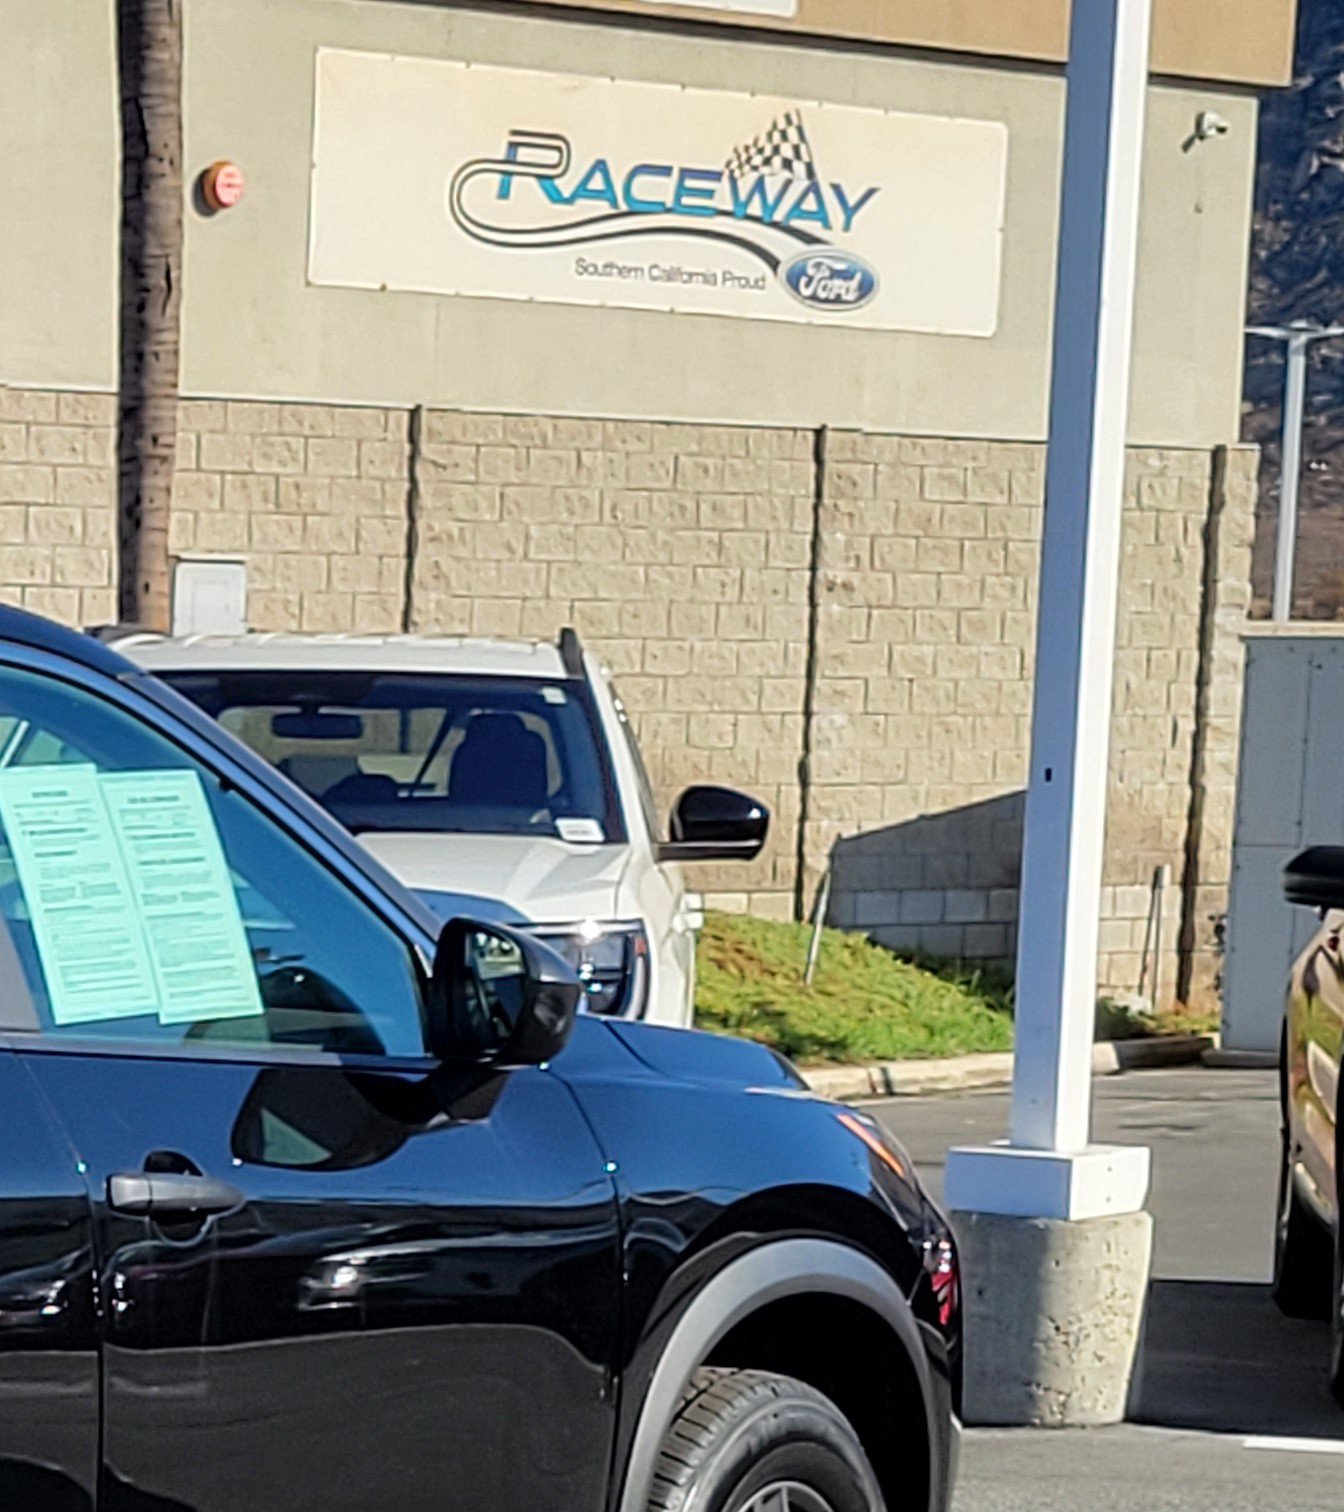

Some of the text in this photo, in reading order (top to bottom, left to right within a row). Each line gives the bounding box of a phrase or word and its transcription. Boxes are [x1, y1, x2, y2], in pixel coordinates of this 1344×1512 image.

[498, 130, 879, 232] RACEWAY
[574, 256, 767, 290] Southern California Proud
[798, 257, 863, 301] Ford
